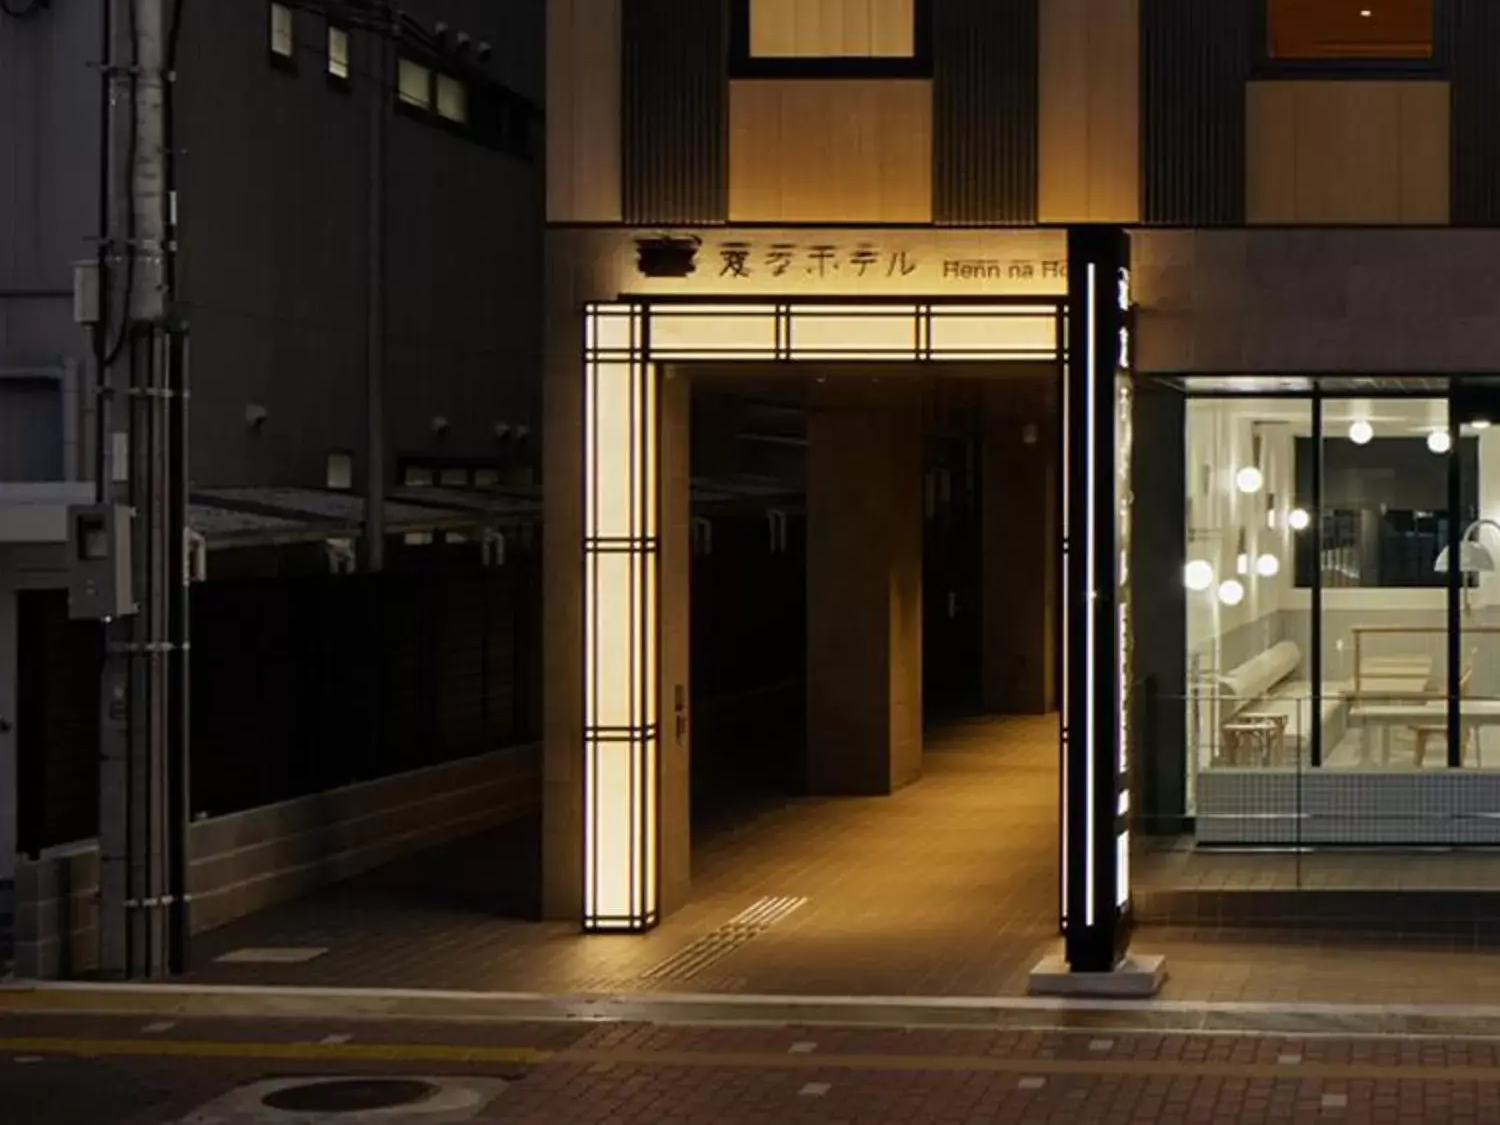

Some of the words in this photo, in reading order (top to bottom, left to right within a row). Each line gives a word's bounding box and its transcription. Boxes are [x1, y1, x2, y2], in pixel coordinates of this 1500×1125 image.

[717, 241, 918, 279] 変なホテル
[943, 259, 1000, 279] Henn
[1008, 263, 1033, 279] na
